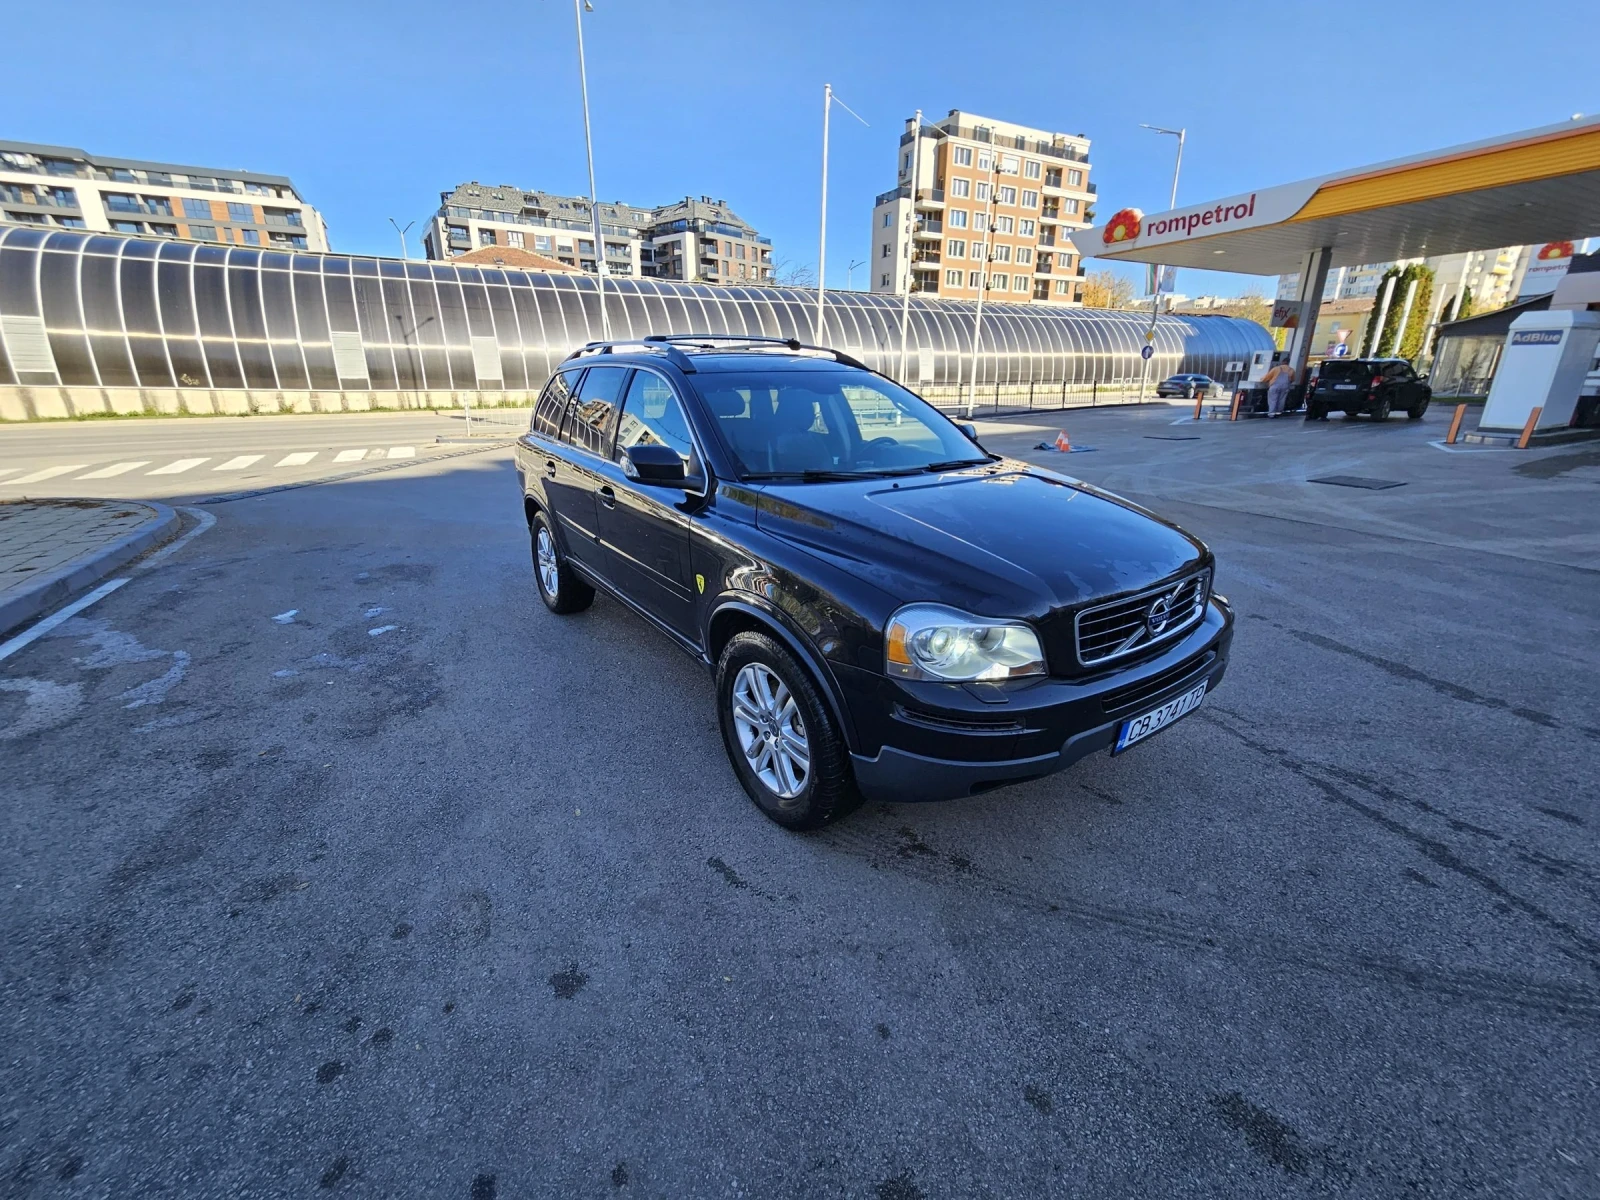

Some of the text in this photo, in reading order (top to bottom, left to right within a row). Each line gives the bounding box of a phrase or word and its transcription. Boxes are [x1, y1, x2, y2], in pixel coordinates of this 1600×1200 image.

[1147, 193, 1257, 236] rompetrol
[1528, 263, 1571, 273] rompetro
[1513, 331, 1561, 343] AdBlue
[1128, 684, 1205, 741] CB 3741 TP
